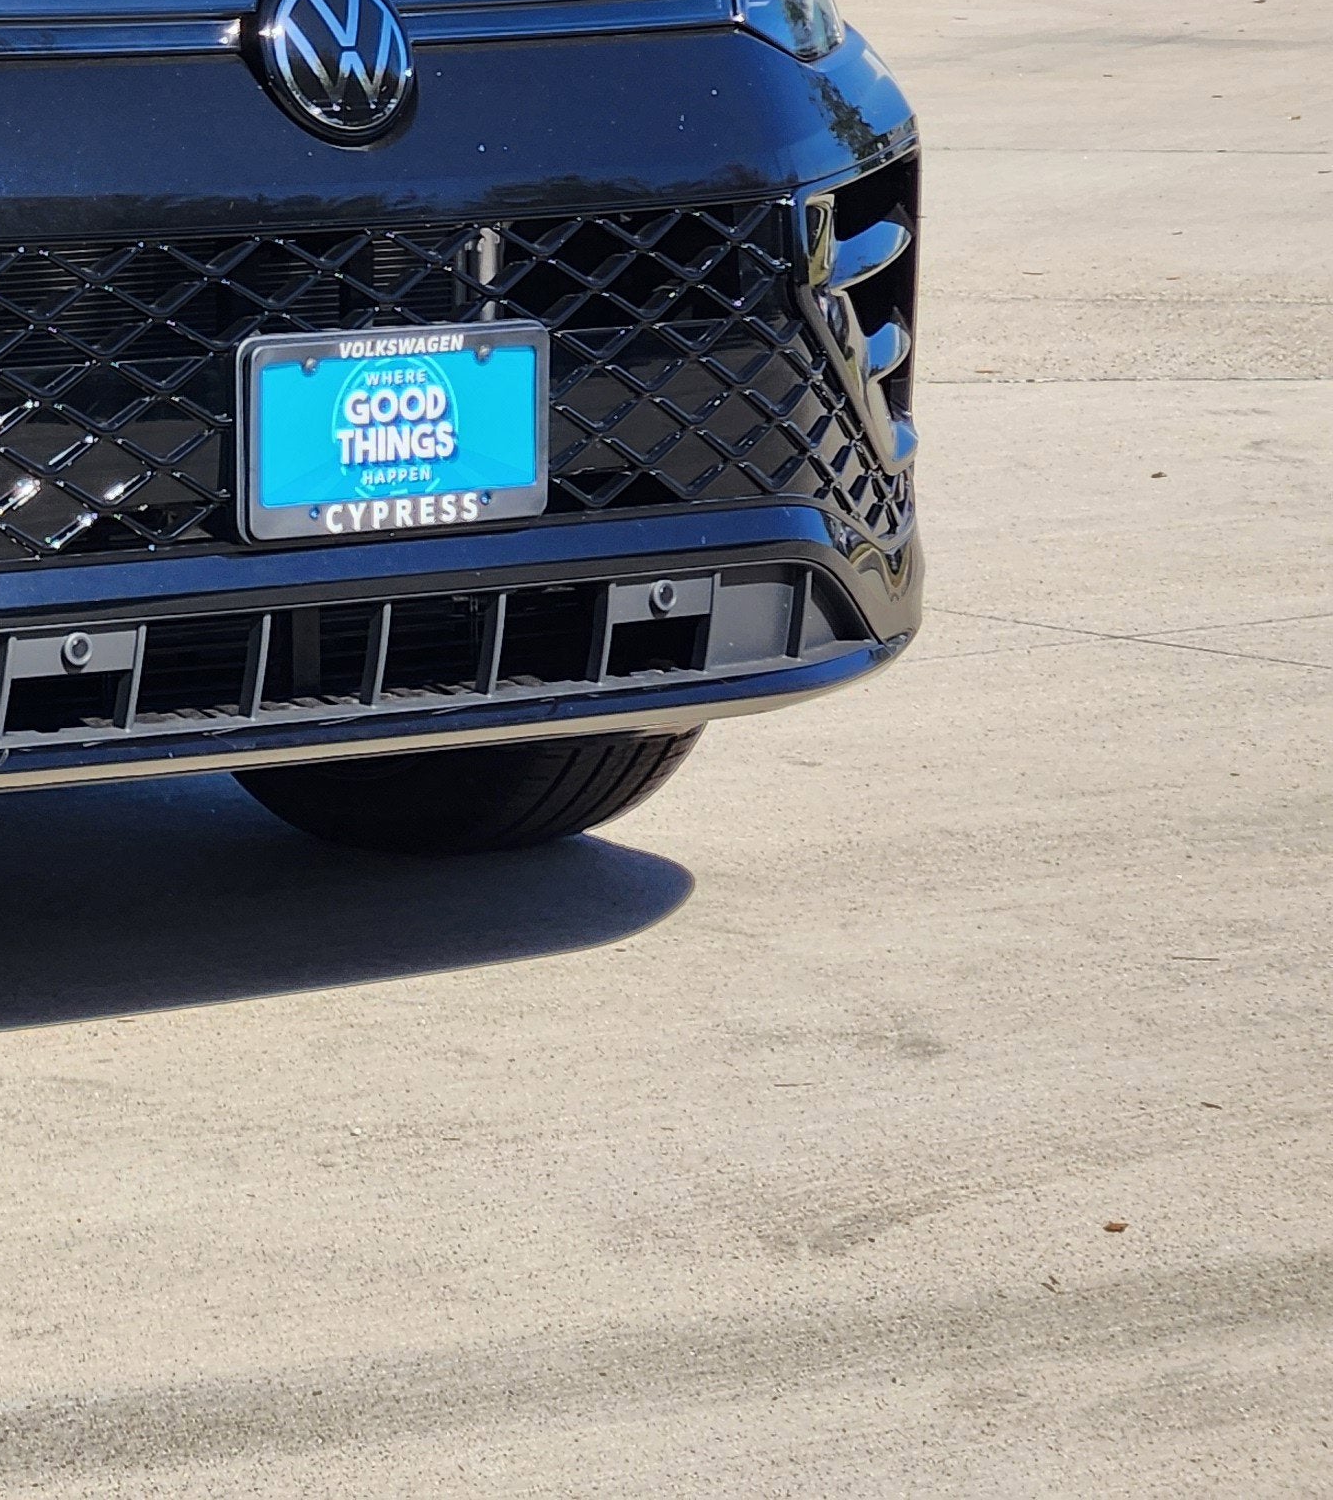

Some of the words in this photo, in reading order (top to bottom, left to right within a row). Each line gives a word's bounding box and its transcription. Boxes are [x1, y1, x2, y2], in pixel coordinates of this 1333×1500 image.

[339, 334, 464, 359] VOLKSWAGEN
[364, 369, 427, 386] WHERE
[344, 385, 446, 426] GOOD
[336, 421, 455, 465] THINGS
[363, 467, 432, 485] HAPPEN
[325, 492, 479, 534] CYPRESS
